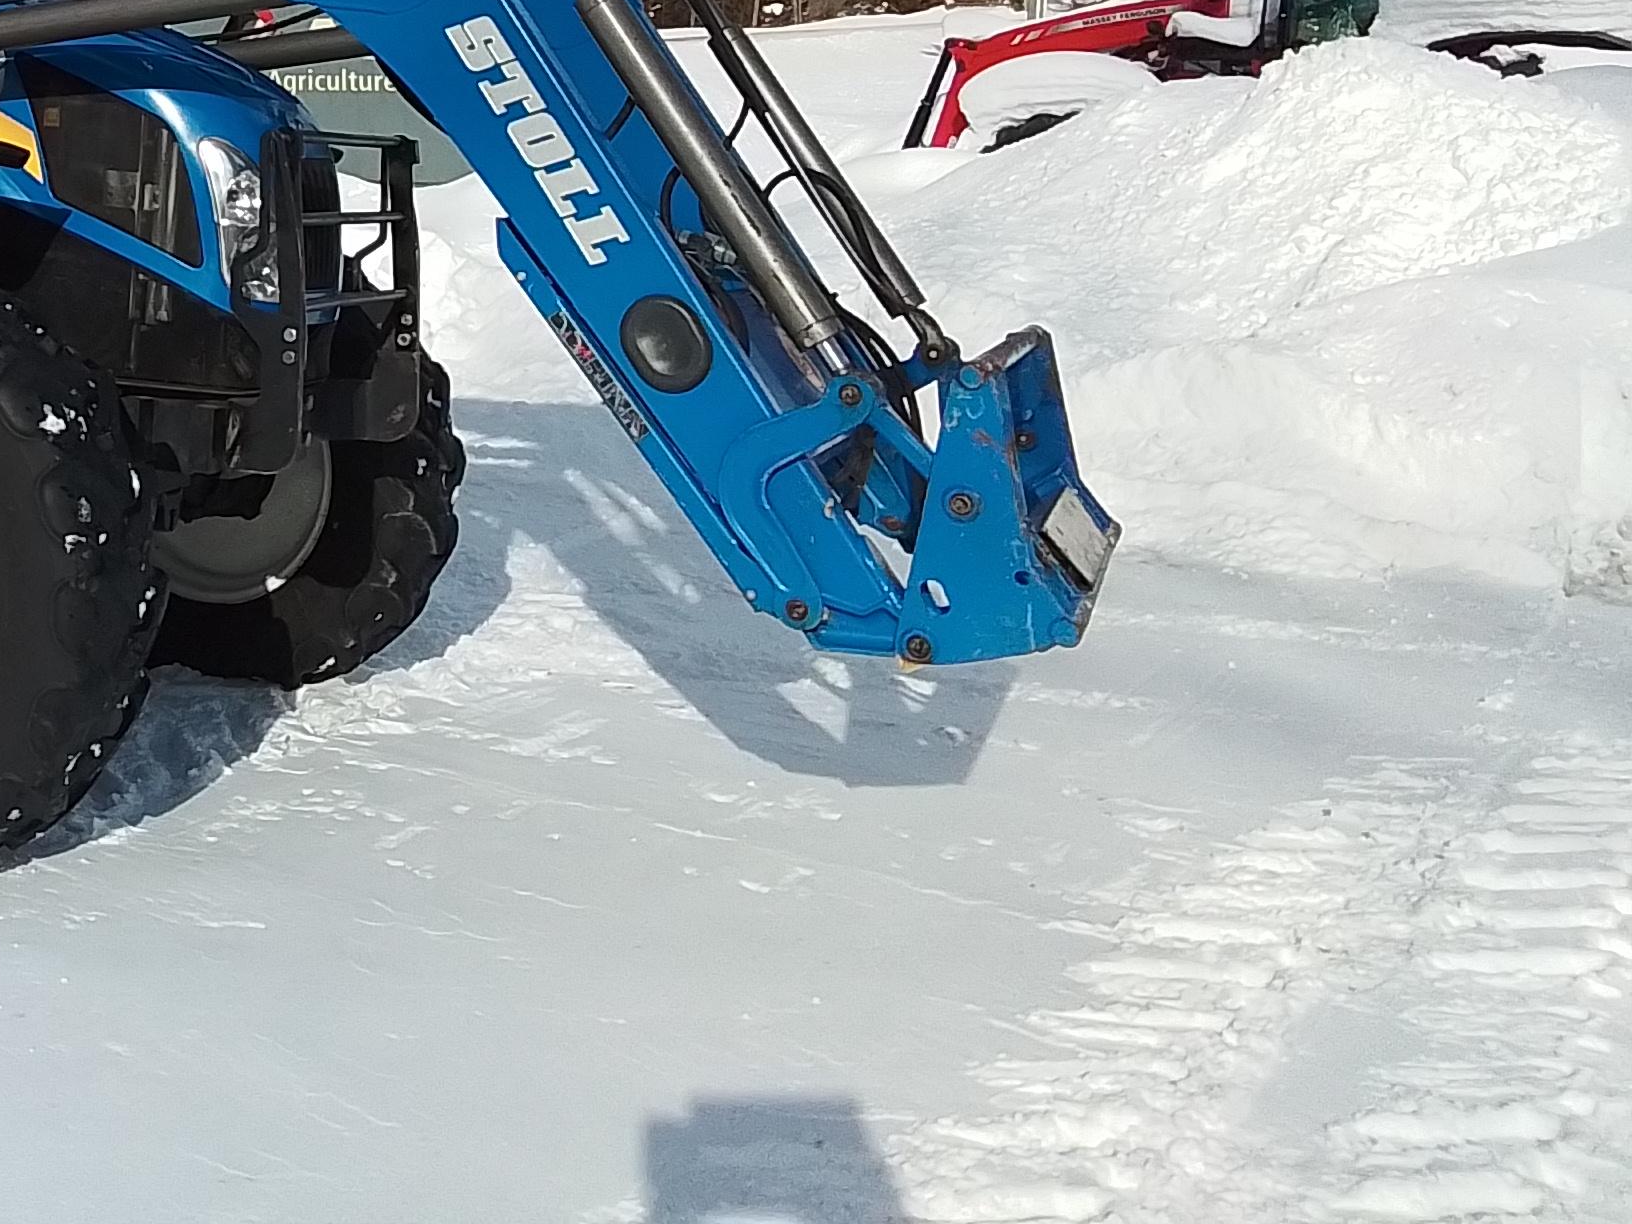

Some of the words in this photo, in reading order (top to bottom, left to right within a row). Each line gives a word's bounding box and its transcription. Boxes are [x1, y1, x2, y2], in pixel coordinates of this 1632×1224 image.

[1081, 14, 1118, 26] MASSEY
[1119, 7, 1167, 20] FERGUSON
[444, 15, 631, 266] STOLL
